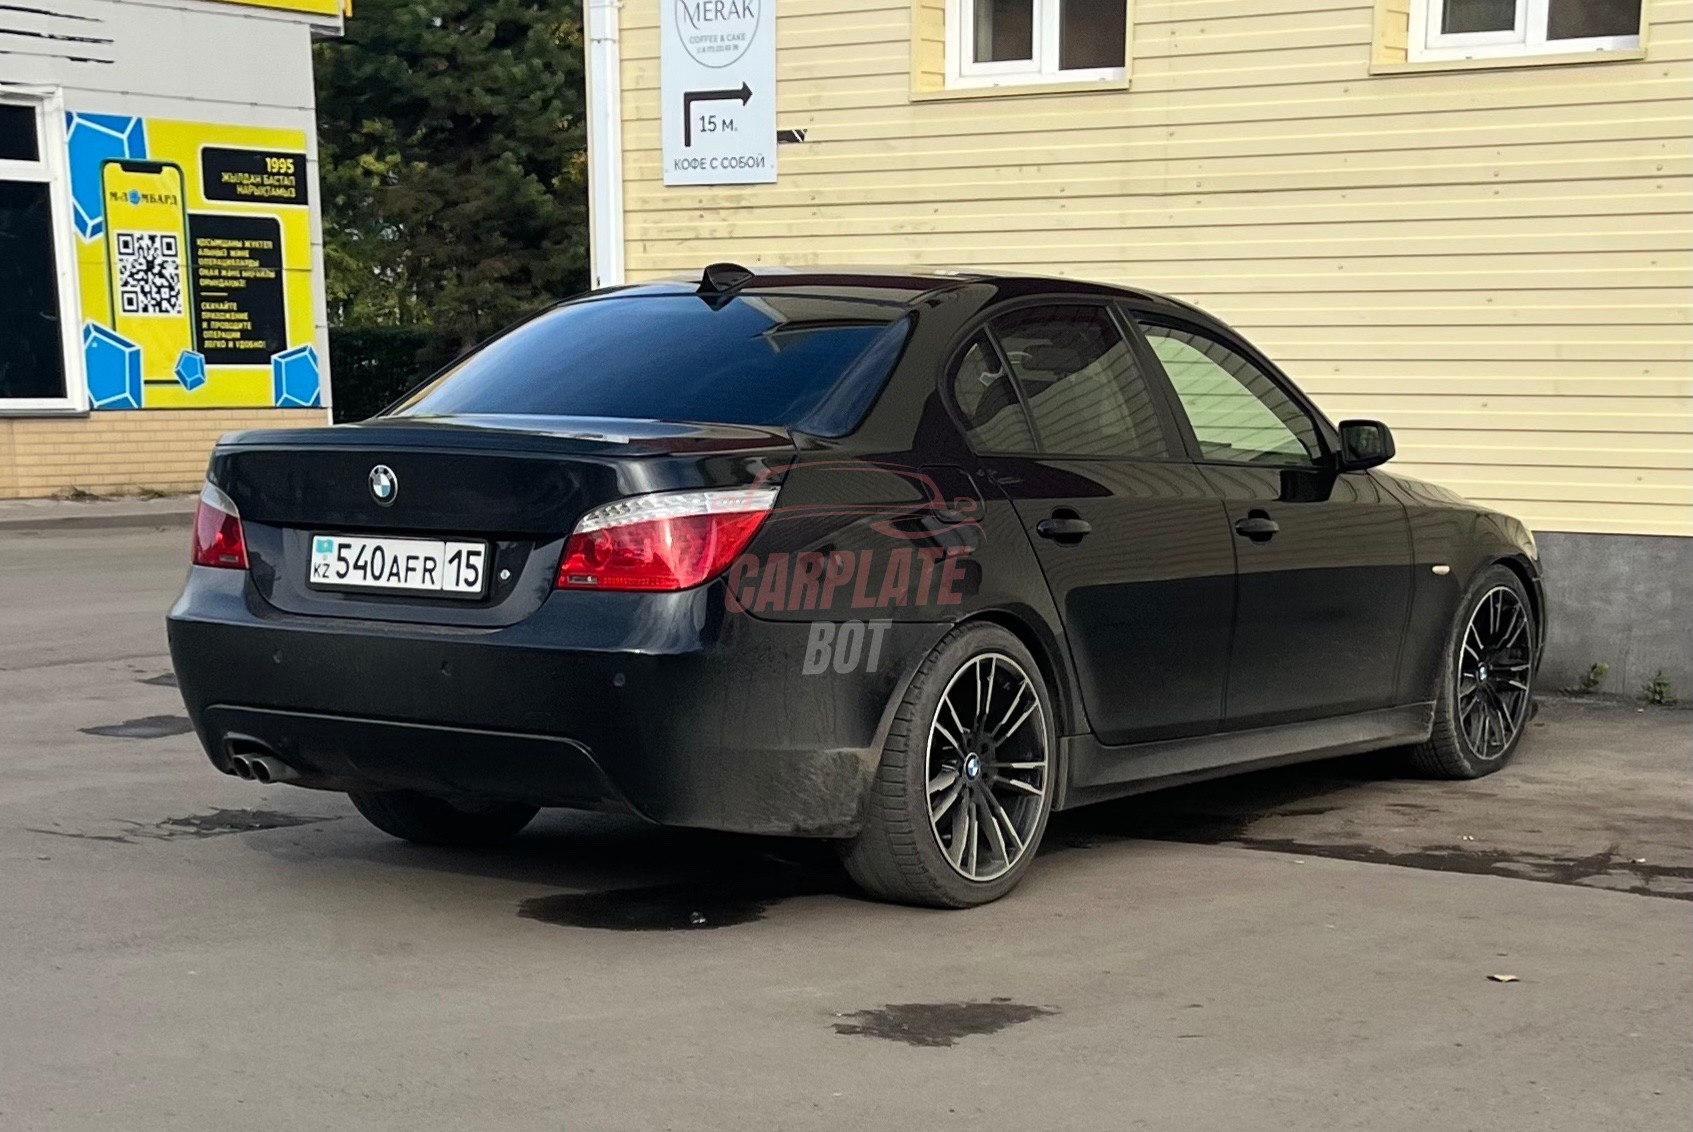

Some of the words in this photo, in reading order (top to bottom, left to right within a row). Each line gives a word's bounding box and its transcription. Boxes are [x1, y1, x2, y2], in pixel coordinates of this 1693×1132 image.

[681, 0, 755, 30] MERAK
[689, 34, 718, 44] COFFEE
[726, 32, 746, 41] CAKE
[699, 115, 717, 133] 15
[265, 157, 295, 174] 1995
[674, 157, 708, 171] КОФЕ
[710, 156, 718, 169] С
[720, 153, 766, 169] СОБОЙ
[263, 174, 296, 186] БАСТАП
[313, 563, 330, 578] KZ
[448, 549, 482, 588] 15
